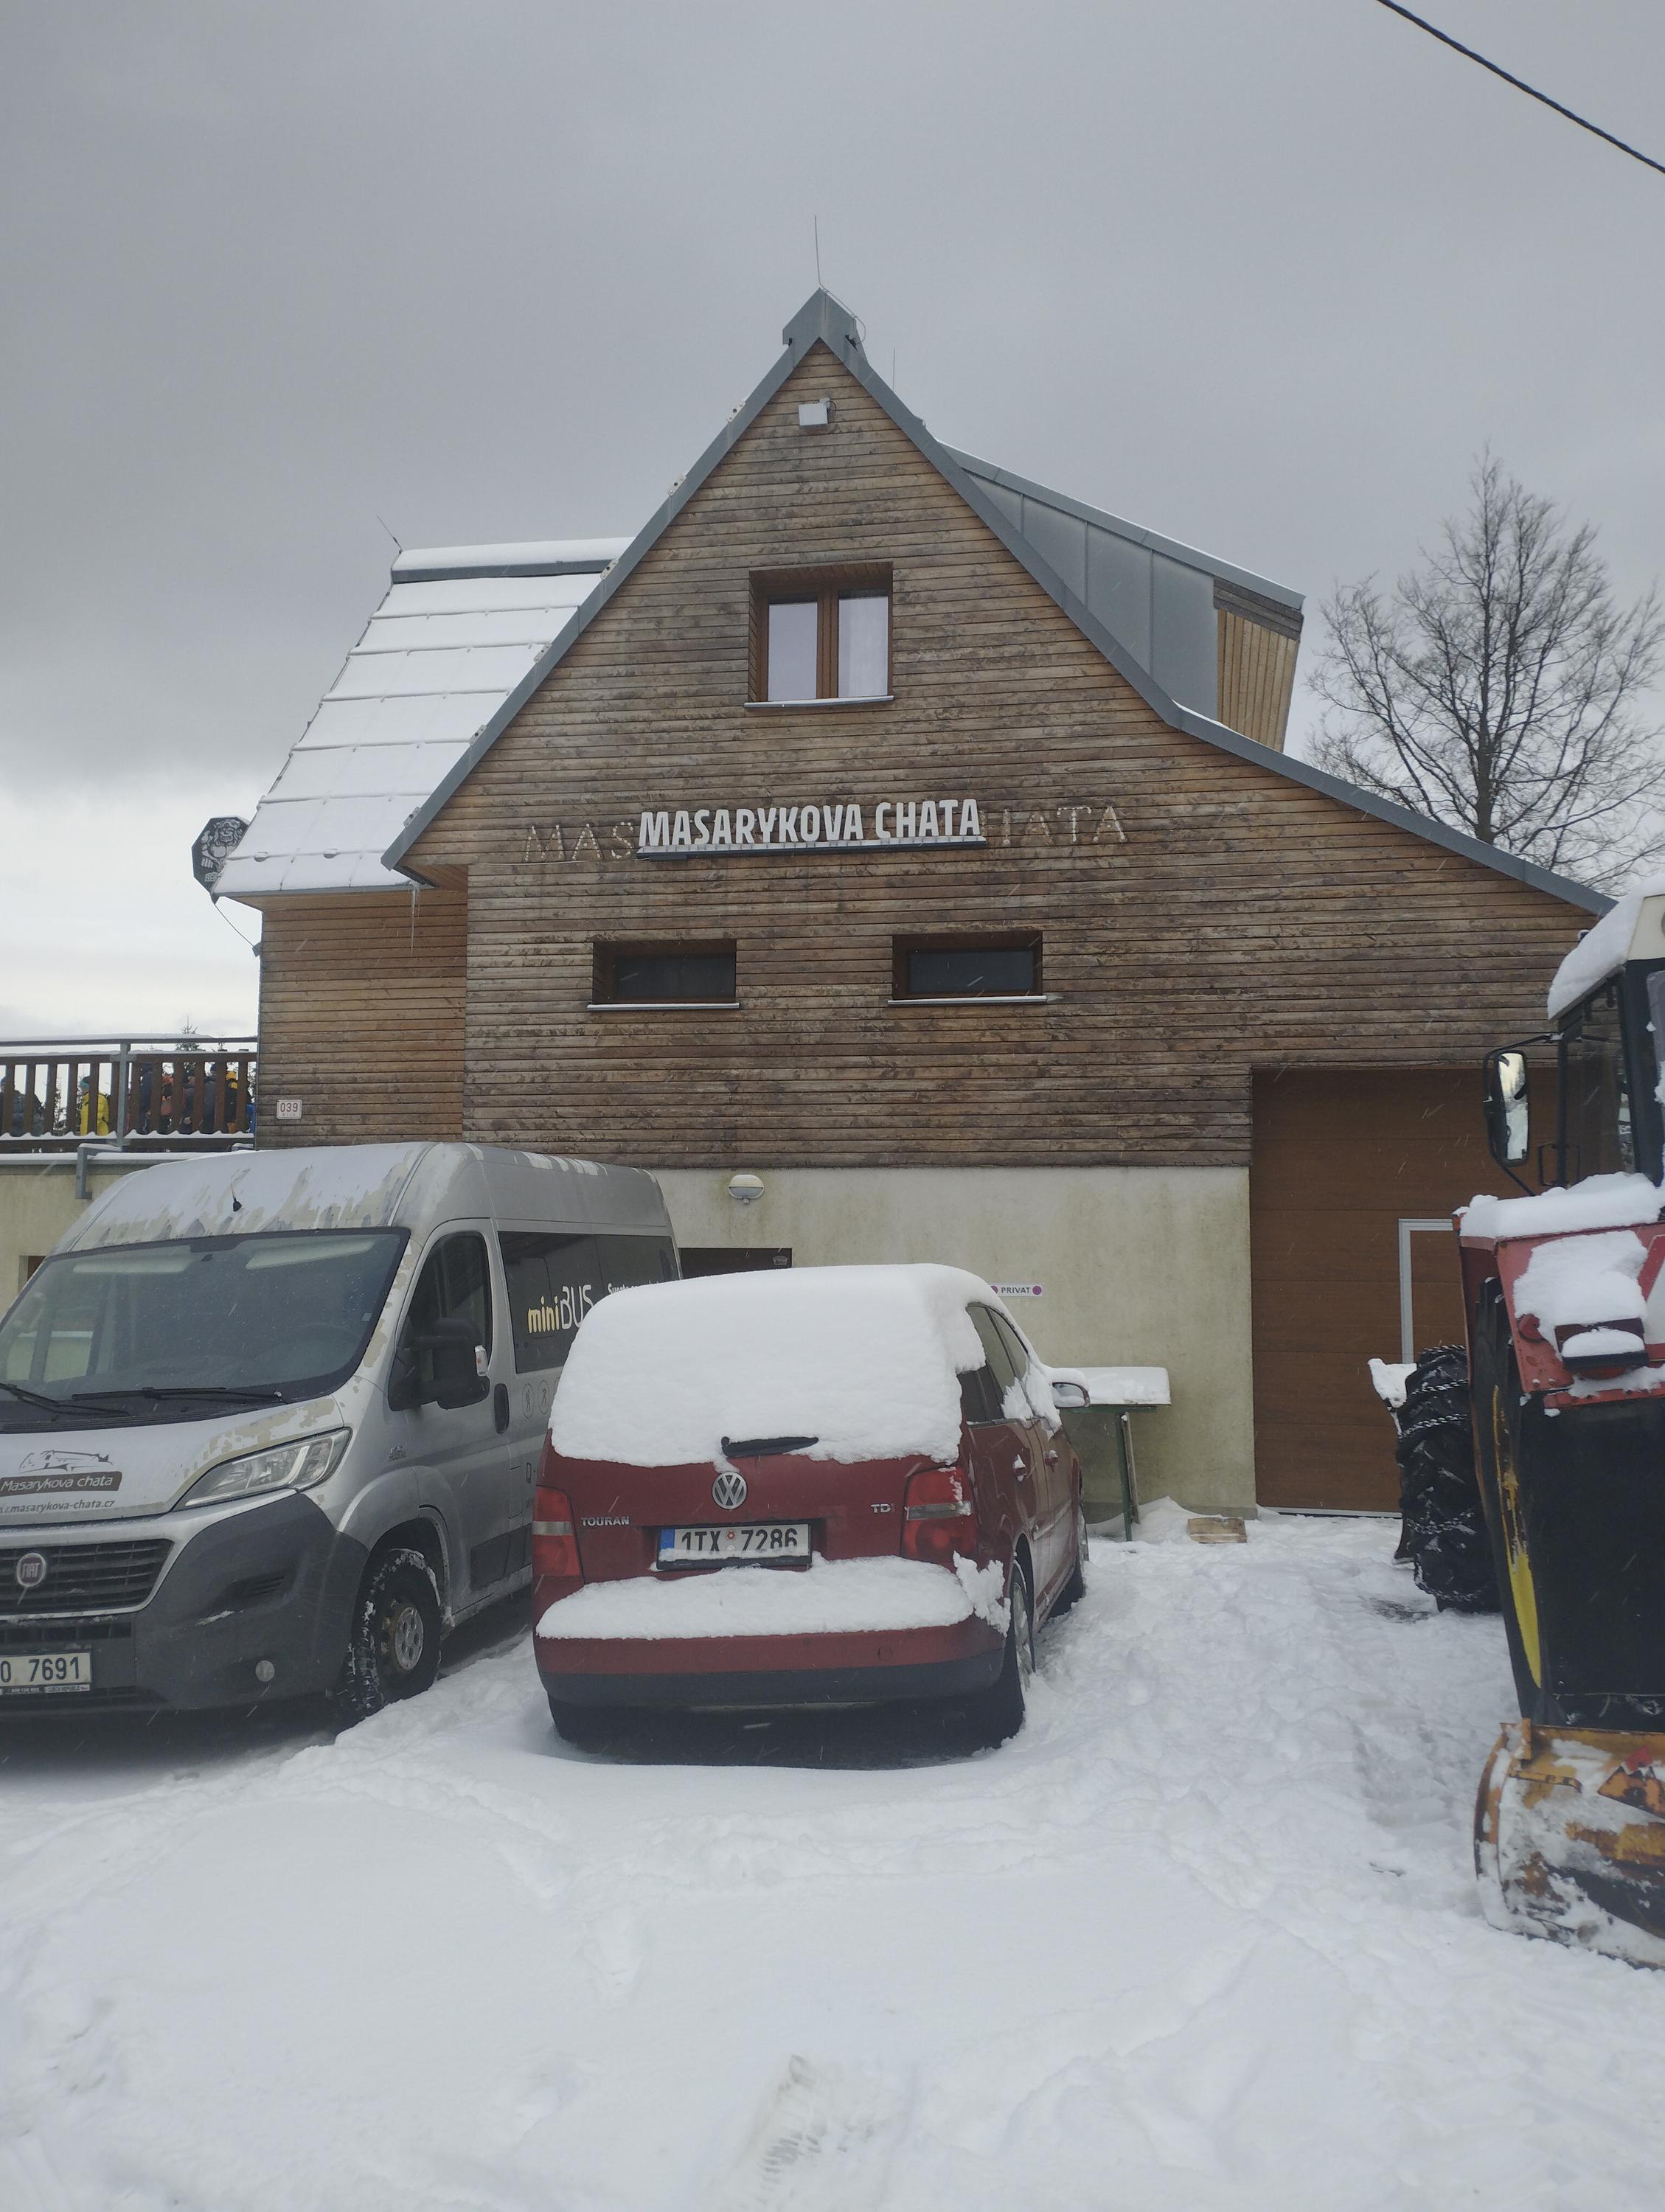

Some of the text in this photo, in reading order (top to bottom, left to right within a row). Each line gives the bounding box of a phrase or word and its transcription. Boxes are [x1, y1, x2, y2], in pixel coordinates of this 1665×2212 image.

[639, 799, 981, 846] MASARYKOVA CHATA
[280, 1102, 299, 1113] 039
[0, 1475, 114, 1492] Masarykova chata
[870, 1503, 895, 1513] TDI
[580, 1515, 630, 1527] TOURAN
[681, 1528, 798, 1552] 1TX 7286
[21, 1562, 41, 1578] FIAT
[28, 1655, 80, 1682] 7691
